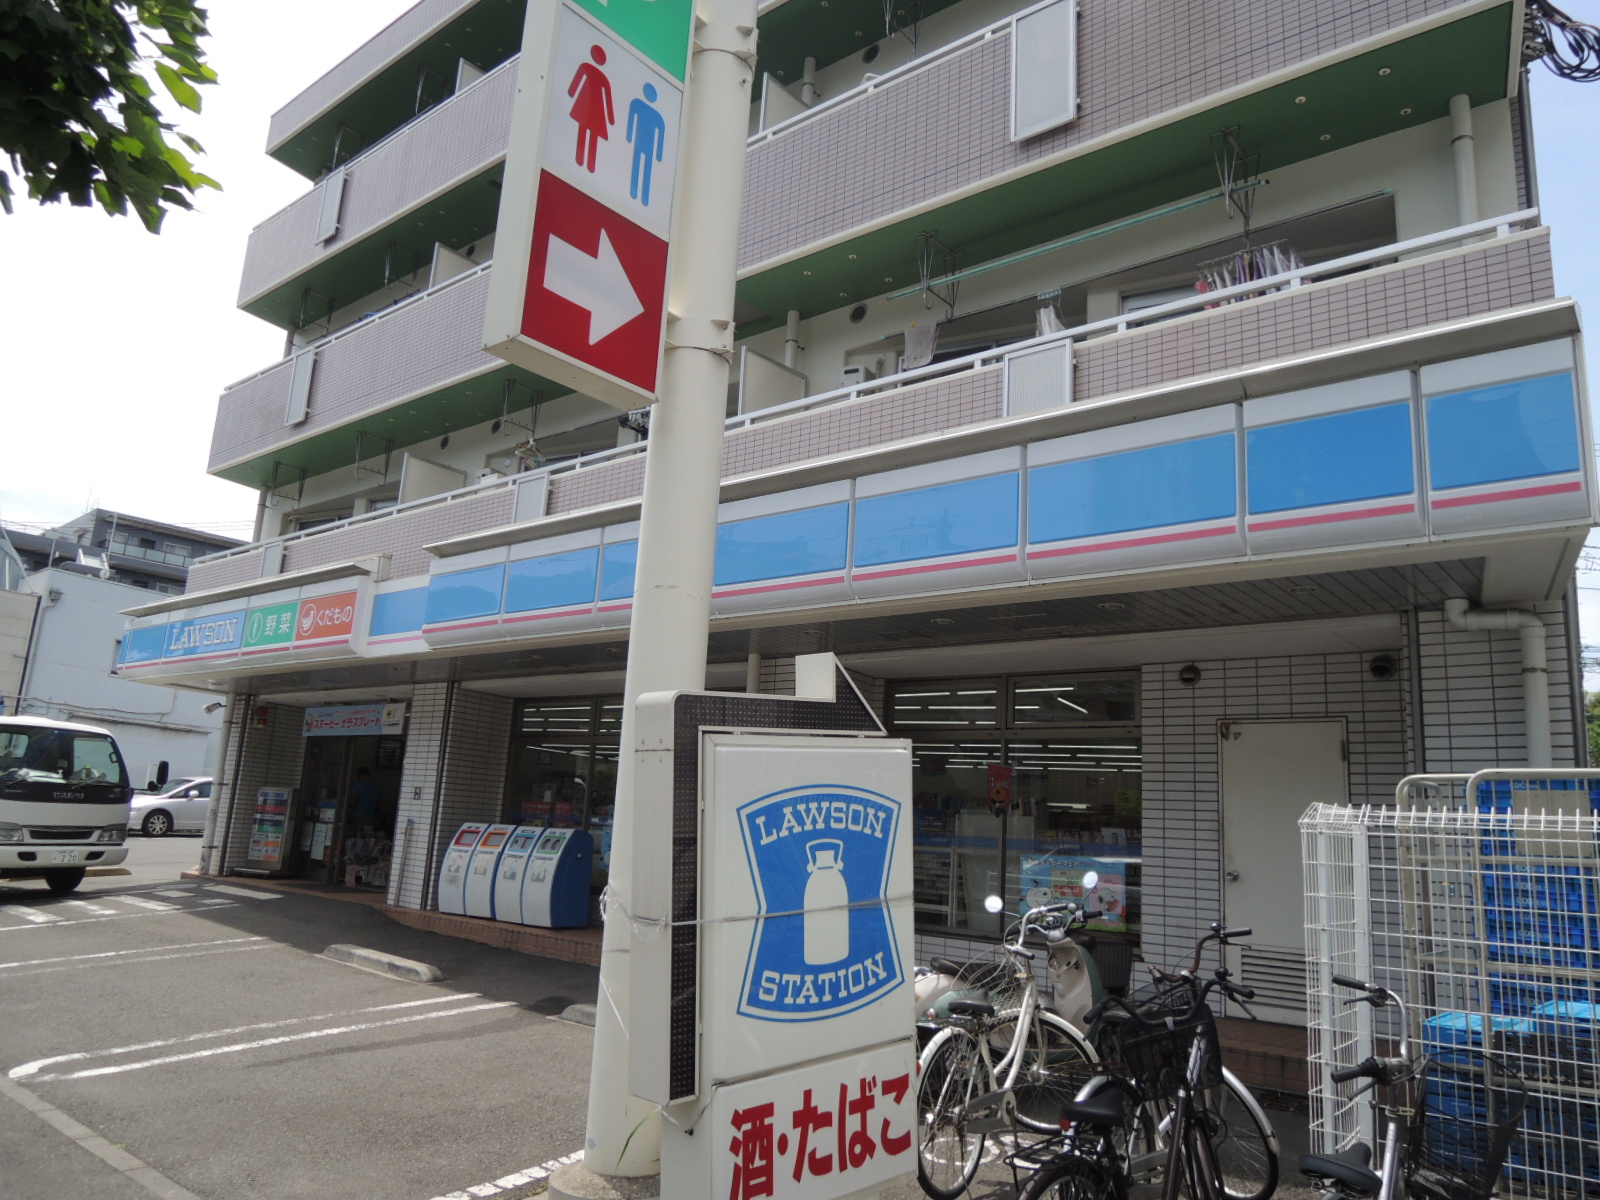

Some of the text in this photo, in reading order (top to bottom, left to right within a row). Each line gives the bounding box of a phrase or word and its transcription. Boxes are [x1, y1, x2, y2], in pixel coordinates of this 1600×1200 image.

[170, 618, 238, 650] LAWSON
[264, 612, 292, 636] 野菜
[315, 605, 353, 626] くだもの
[755, 801, 887, 846] LAWSON
[758, 951, 888, 1005] STATION
[729, 1074, 912, 1200] 酒・たばこ
